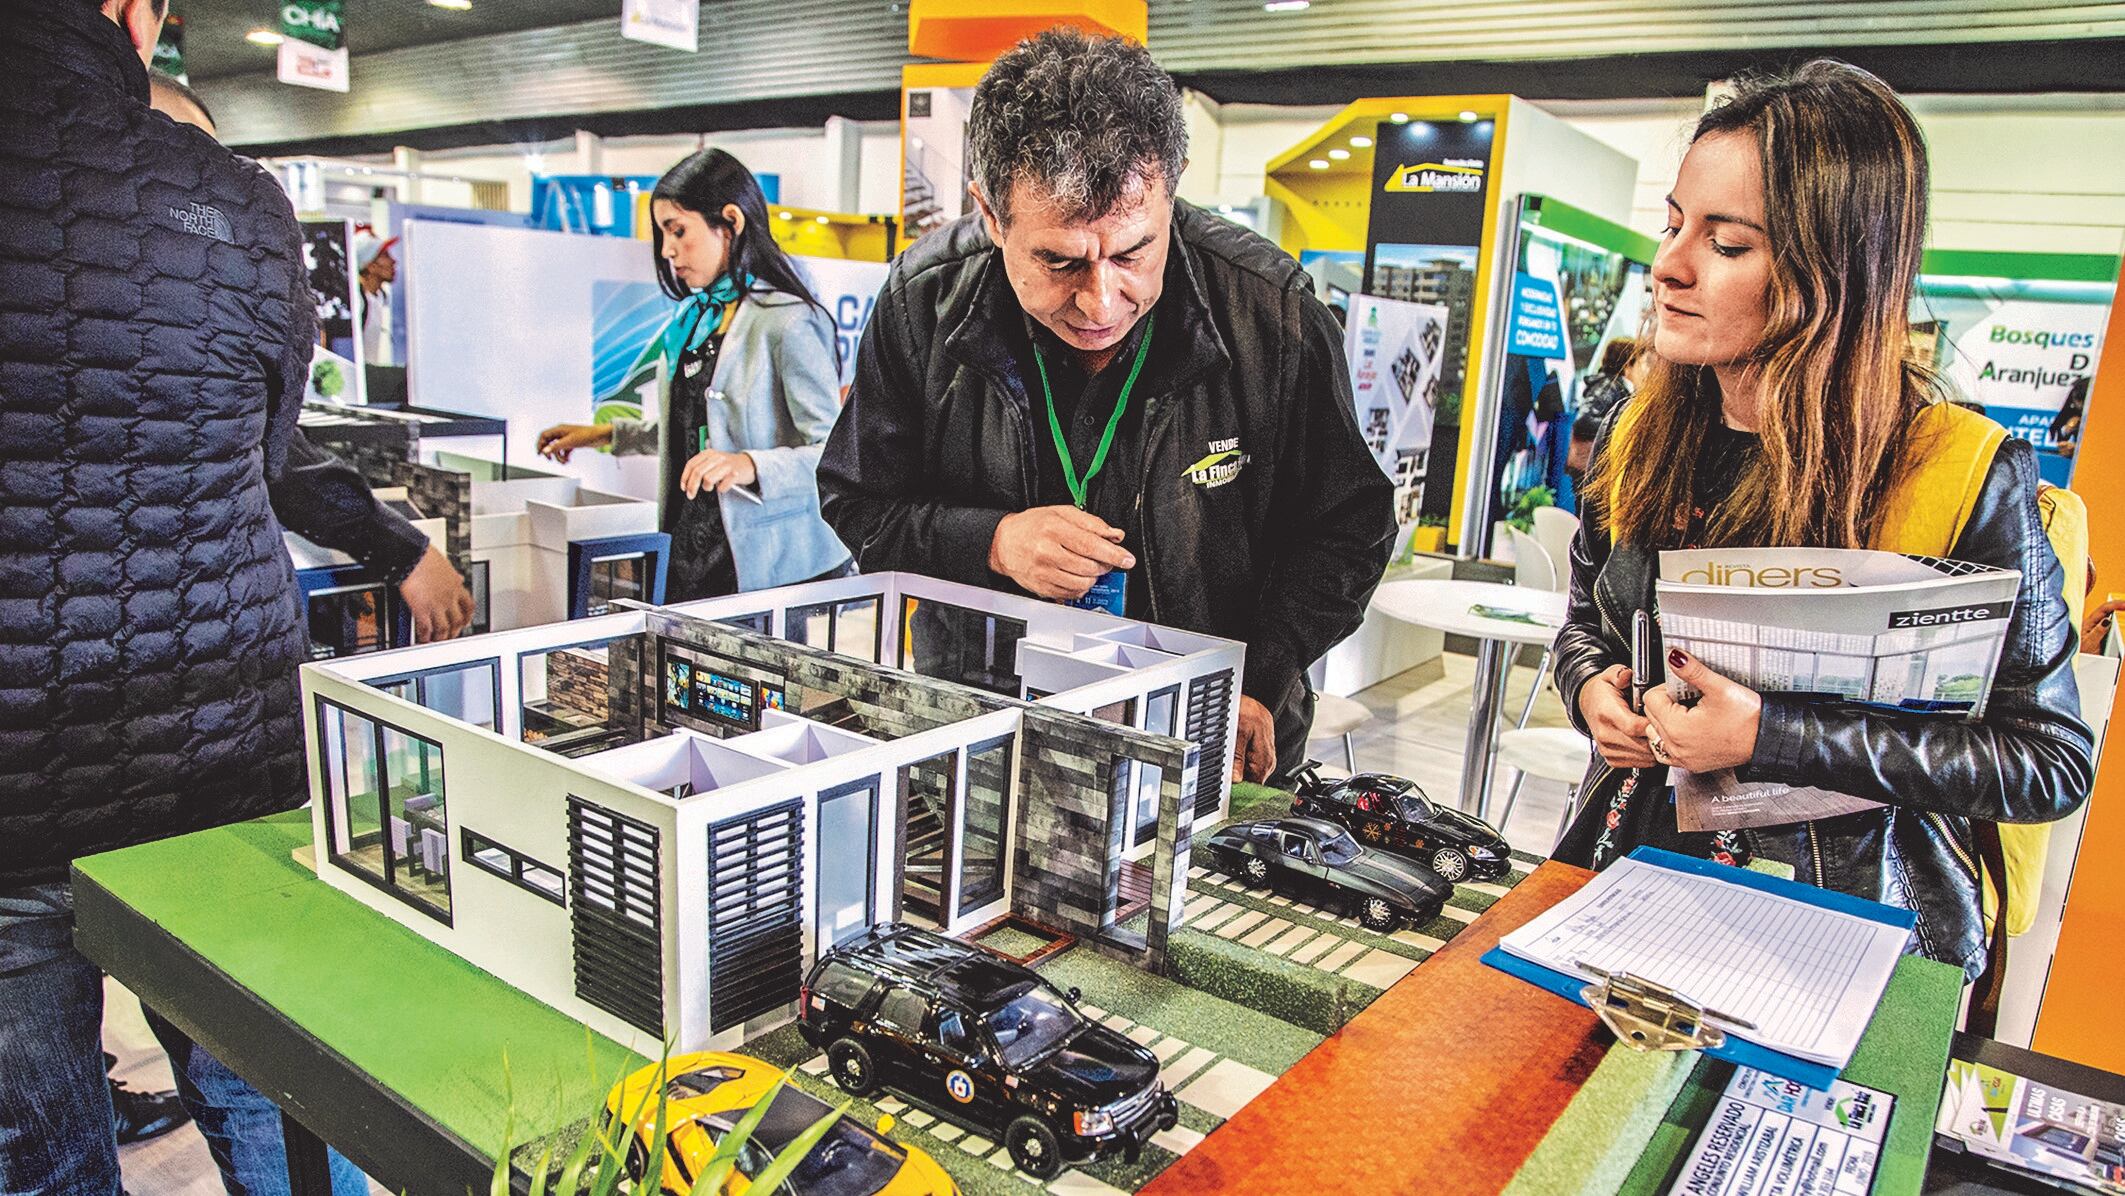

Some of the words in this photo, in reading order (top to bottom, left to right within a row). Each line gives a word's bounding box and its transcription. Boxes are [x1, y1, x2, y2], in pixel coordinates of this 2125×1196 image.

[1402, 172, 1419, 188] La
[1421, 170, 1481, 190] Mansión
[169, 207, 215, 230] NORTH
[190, 201, 215, 219] THE
[183, 221, 217, 239] FACE
[1990, 325, 2095, 349] Bosques
[1978, 360, 2083, 390] Aranjuez
[1208, 437, 1239, 454] VENDE
[1191, 469, 1208, 483] La
[1682, 561, 1842, 588] diners
[1895, 607, 1990, 627] zientte
[1711, 795, 1721, 804] A
[1722, 790, 1771, 803] beautiful
[1772, 787, 1791, 798] life
[1686, 1151, 1721, 1195] ANGELES
[1707, 1102, 1746, 1153] RESERVADO
